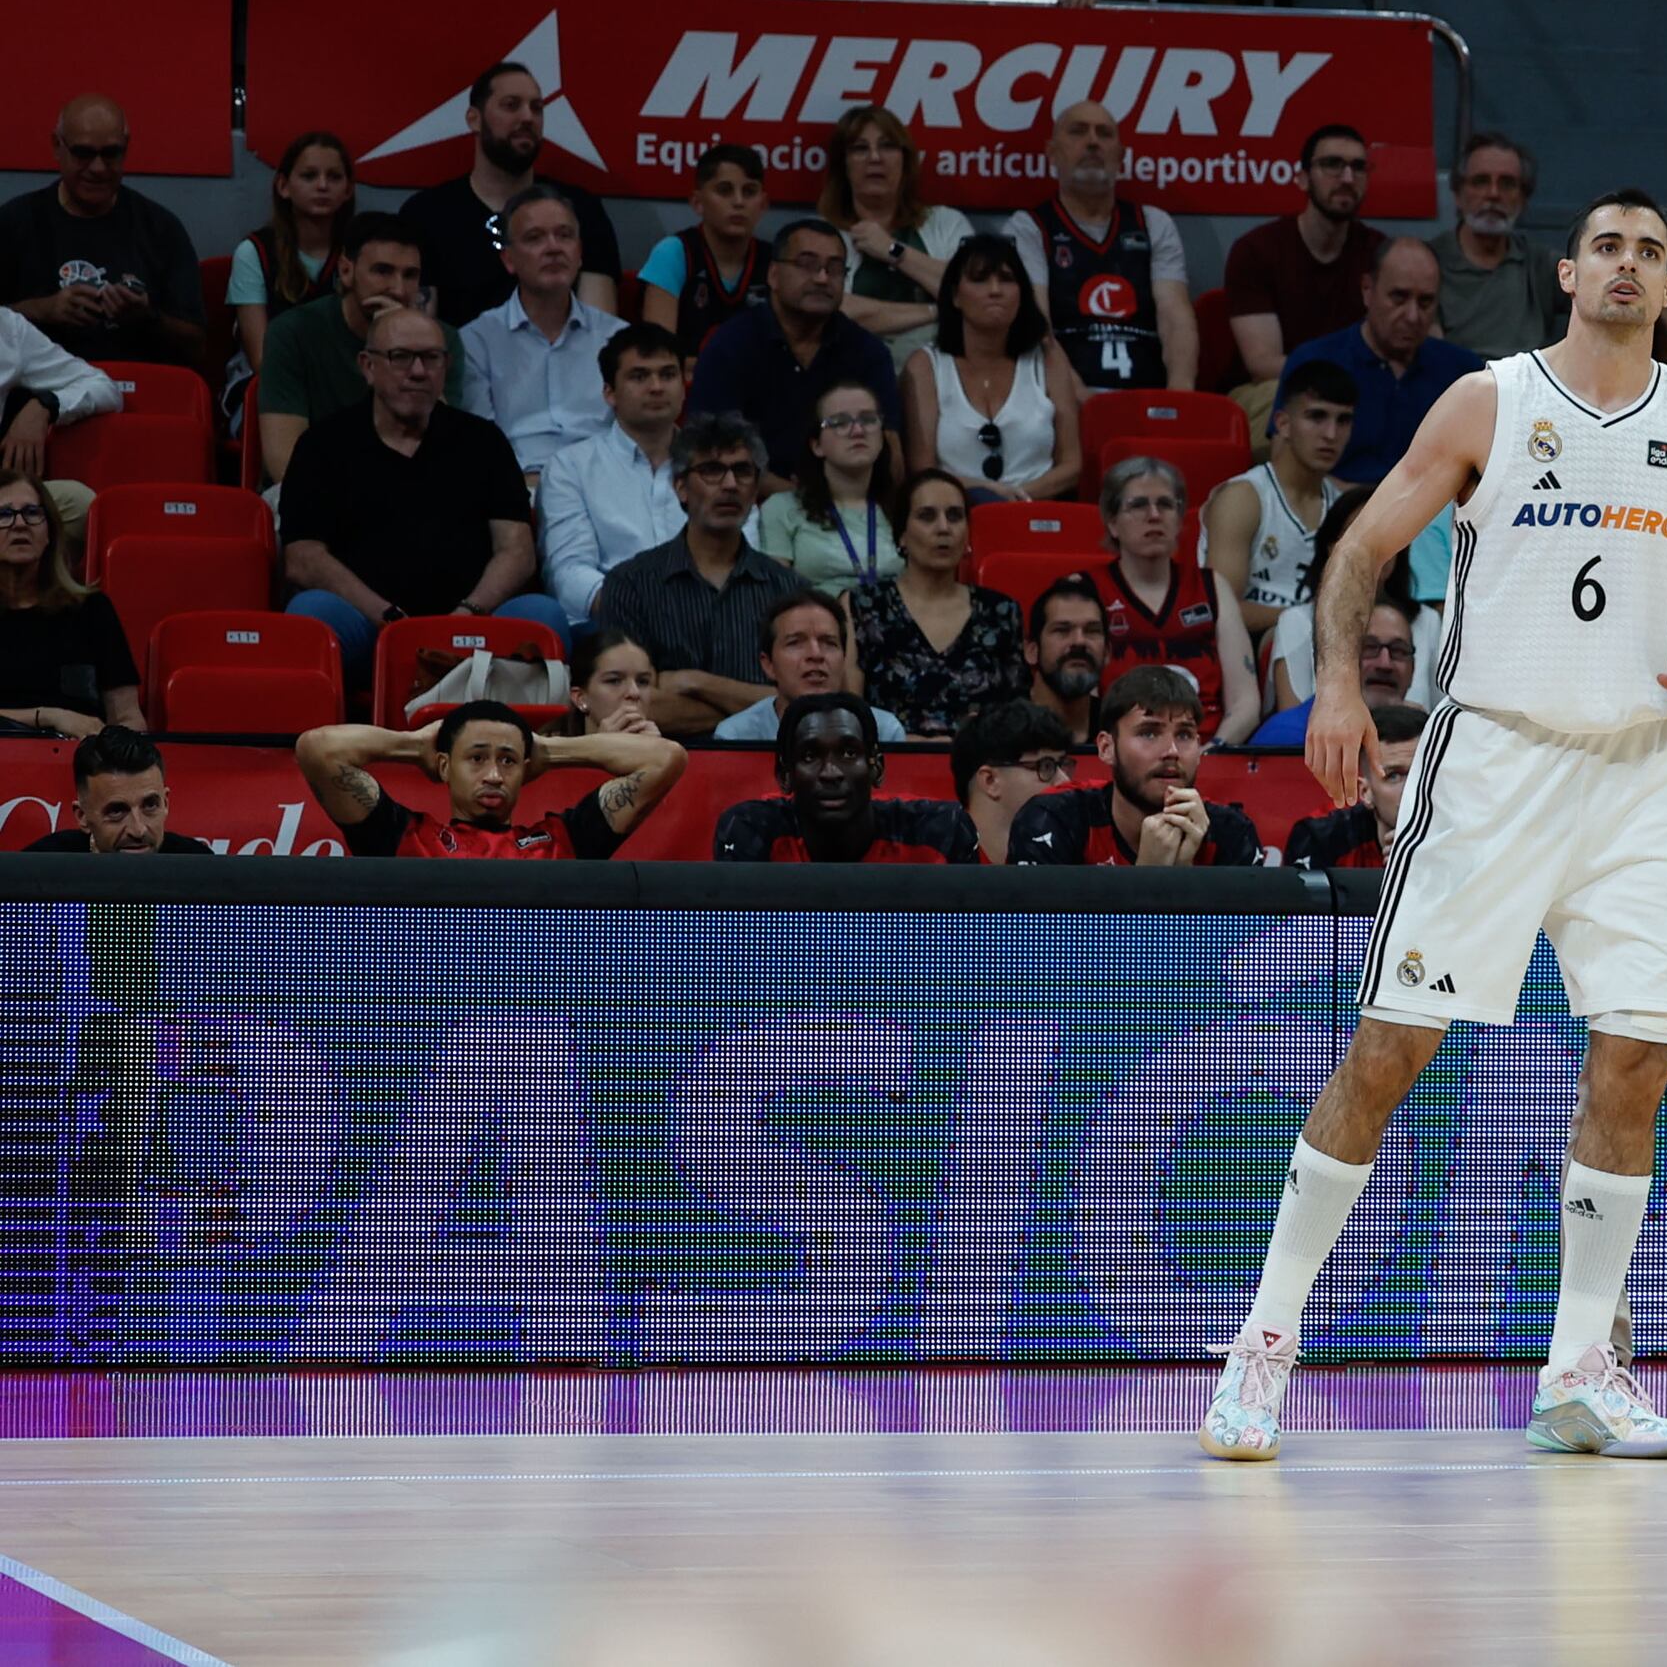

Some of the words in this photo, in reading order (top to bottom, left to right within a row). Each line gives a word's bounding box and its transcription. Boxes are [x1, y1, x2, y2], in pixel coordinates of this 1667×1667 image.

[638, 29, 1333, 141] MERCURY
[1101, 341, 1134, 381] 4
[1571, 555, 1606, 622] 6
